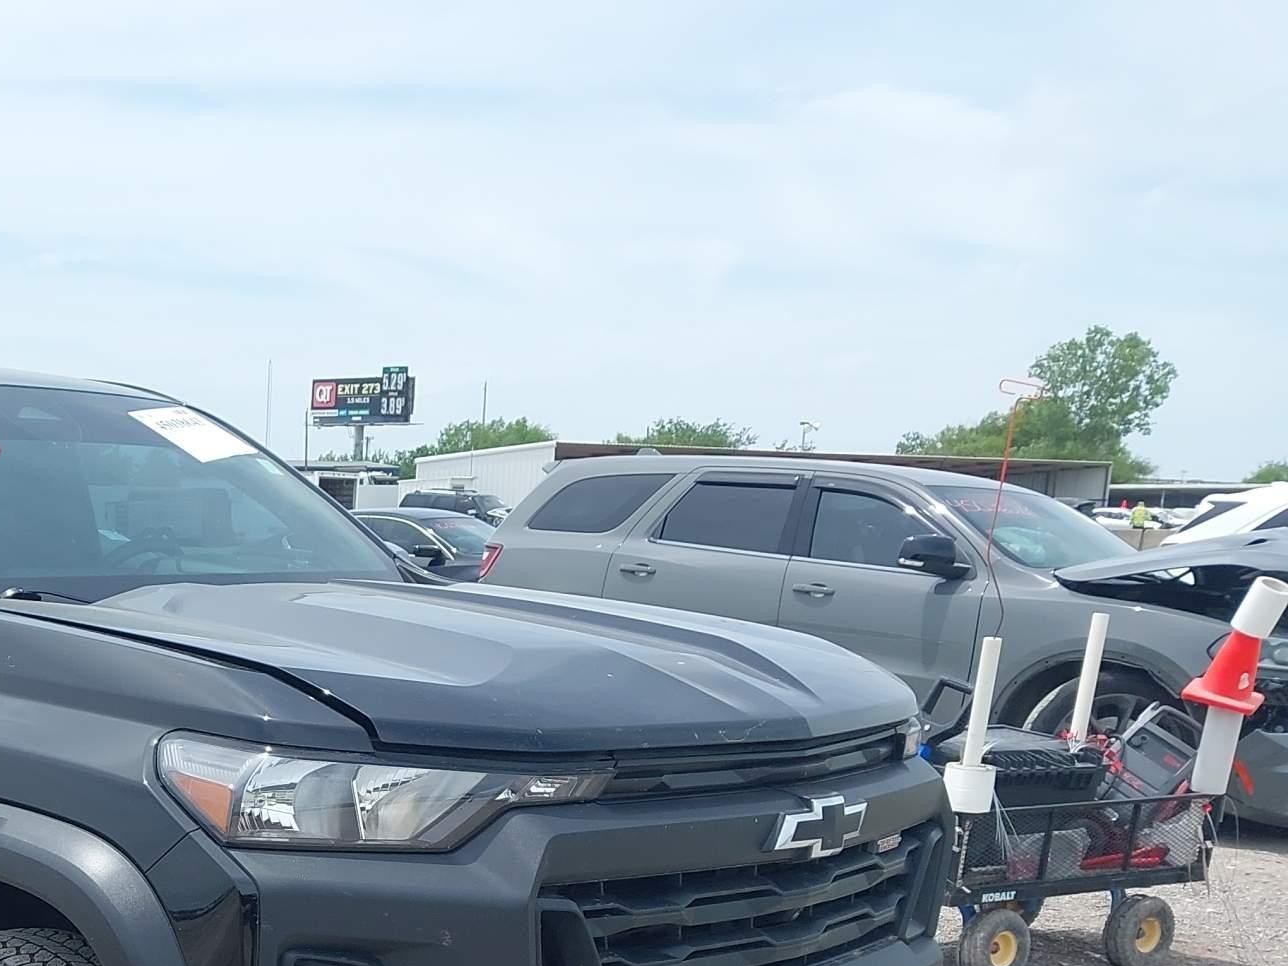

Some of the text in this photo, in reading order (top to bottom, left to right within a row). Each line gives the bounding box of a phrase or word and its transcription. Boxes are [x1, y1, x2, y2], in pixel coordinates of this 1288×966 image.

[315, 385, 333, 403] QT
[337, 384, 360, 395] EXIT
[362, 383, 381, 394] 273
[982, 890, 1017, 903] KOBALT
